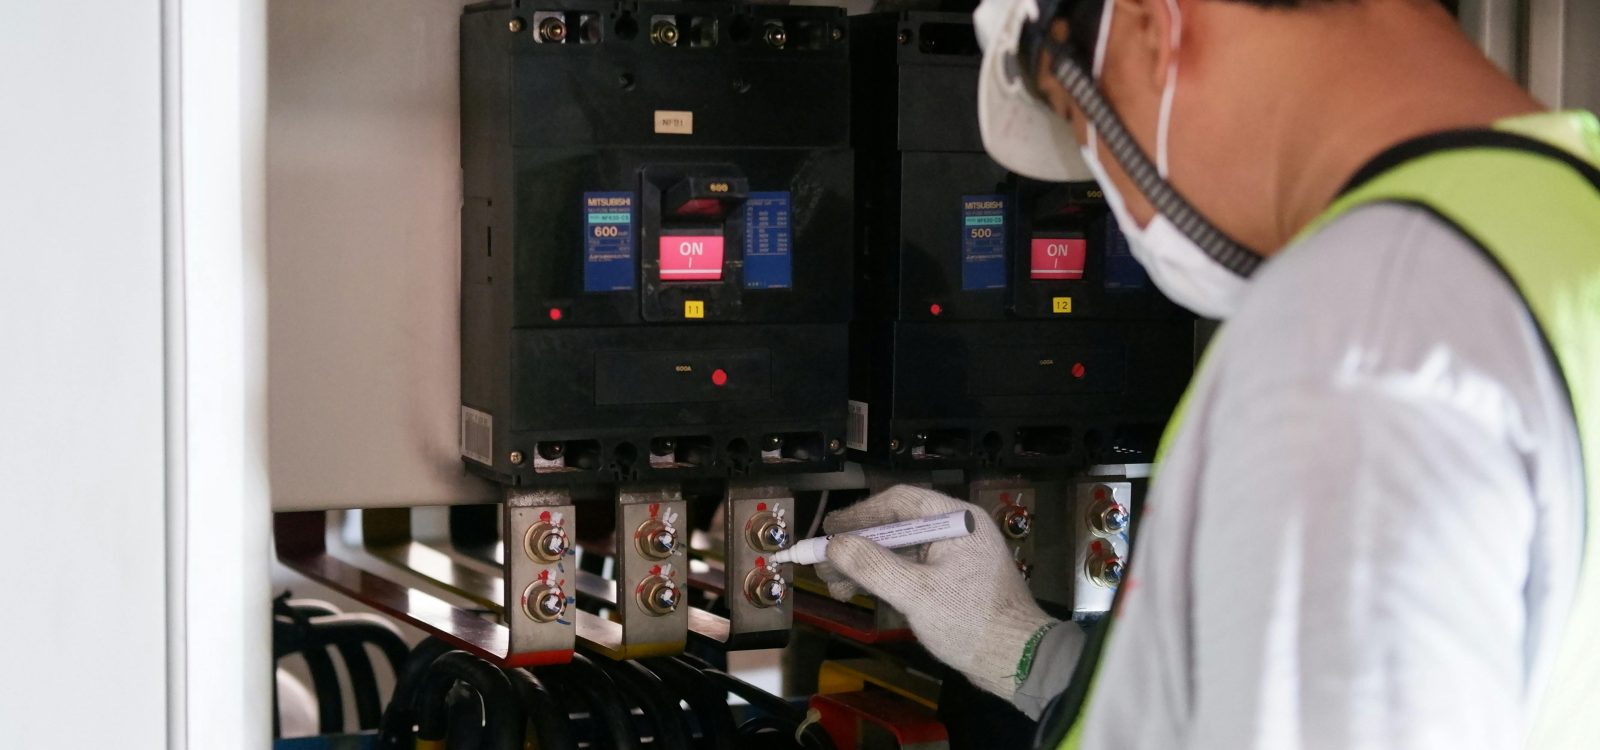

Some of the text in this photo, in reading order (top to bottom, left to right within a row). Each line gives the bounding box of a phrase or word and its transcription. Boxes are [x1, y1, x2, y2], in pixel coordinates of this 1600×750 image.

[588, 198, 631, 206] MITSUBISHI
[965, 201, 1003, 209] MITSUBISHI
[594, 226, 617, 237] 600
[971, 228, 991, 238] 500
[680, 241, 703, 256] ON
[1047, 244, 1068, 257] ON
[688, 305, 699, 314] 11
[1057, 301, 1068, 310] 12
